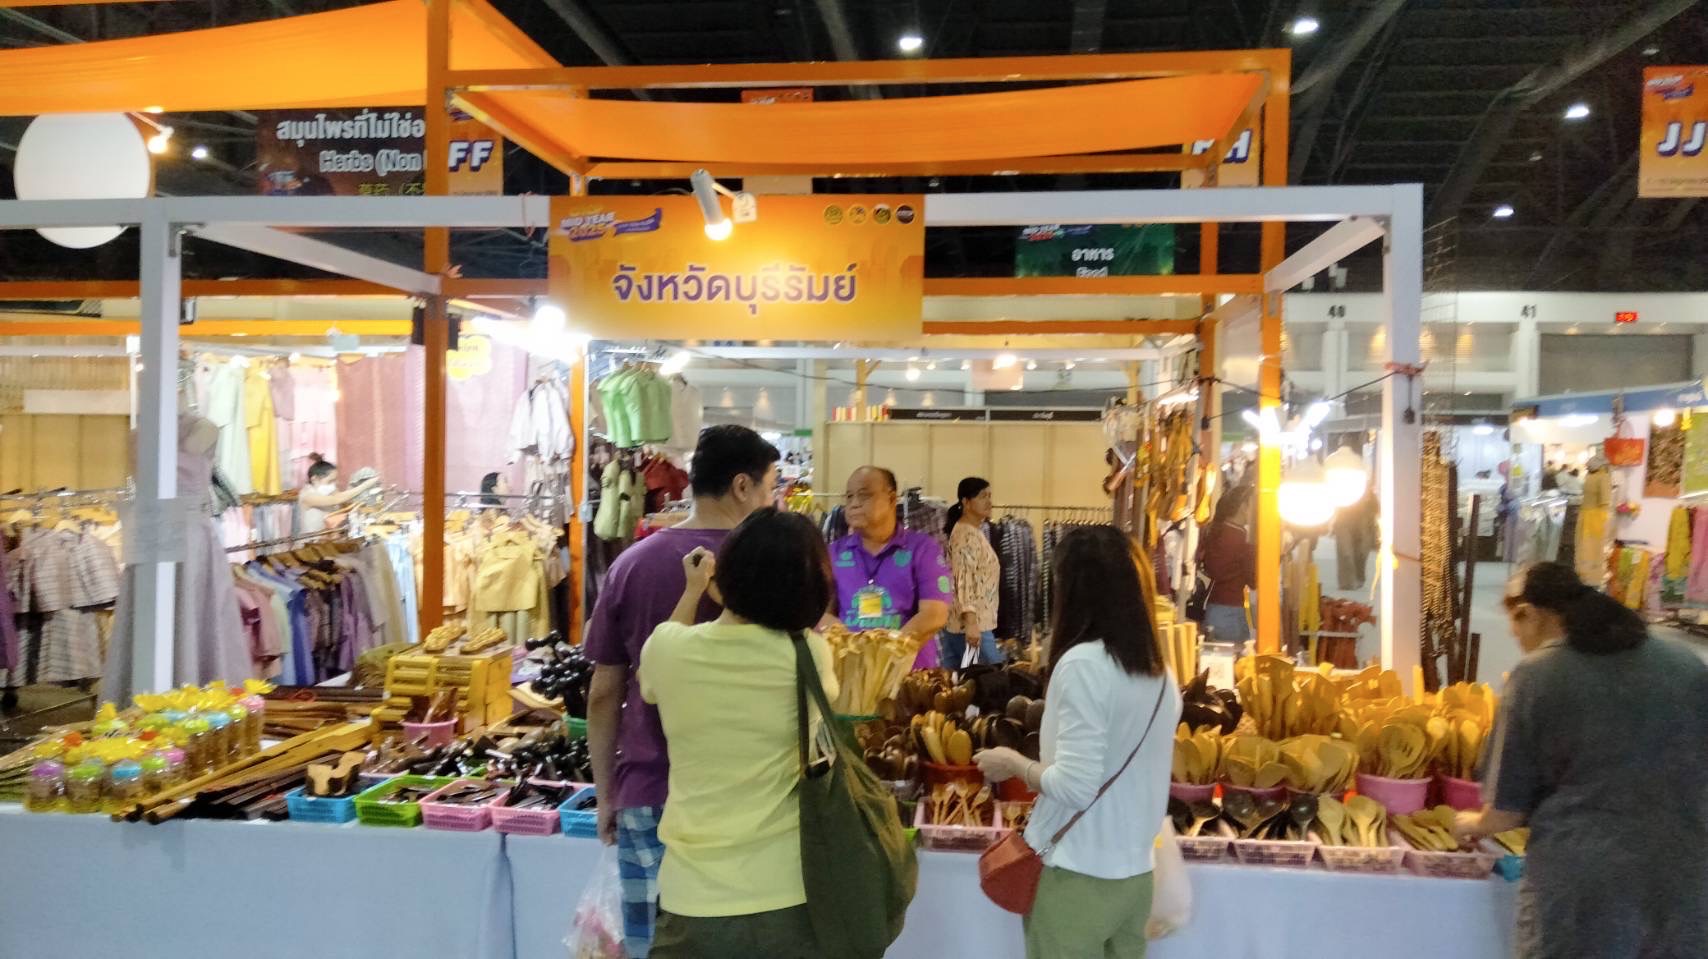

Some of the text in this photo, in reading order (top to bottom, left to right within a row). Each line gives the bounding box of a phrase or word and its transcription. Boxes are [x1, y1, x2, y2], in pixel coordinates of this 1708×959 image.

[1656, 122, 1707, 156] JJ
[319, 149, 422, 176] Herbs (Non
[447, 140, 493, 172] FF
[1071, 248, 1115, 261] อาหาร
[612, 263, 858, 315] จังหวัดบุรีรัมย์
[1520, 304, 1536, 319] 41
